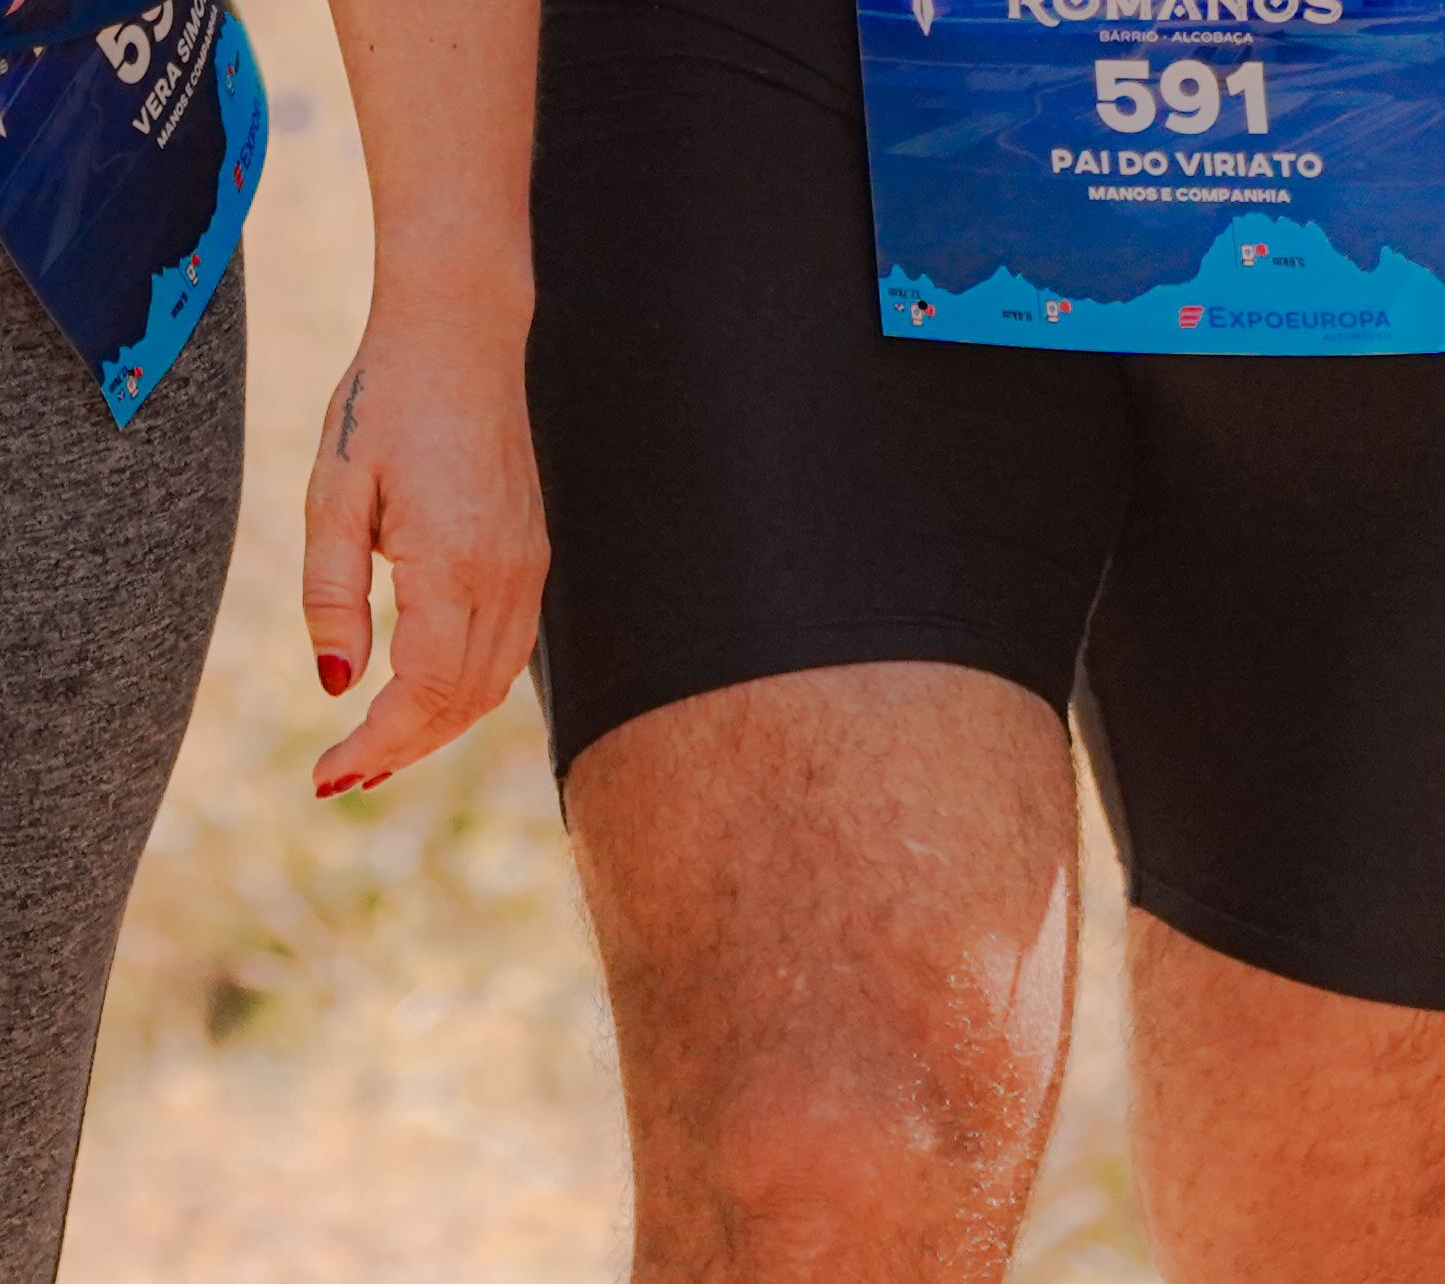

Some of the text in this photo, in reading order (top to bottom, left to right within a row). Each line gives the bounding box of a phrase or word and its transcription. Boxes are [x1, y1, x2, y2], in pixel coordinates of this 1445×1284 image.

[1171, 31, 1254, 46] ALCOBAÇA
[132, 62, 182, 134] VERA
[1095, 59, 1269, 135] 591
[156, 93, 189, 149] MANOS
[1051, 148, 1323, 178] PAI DO VIRIATO
[1088, 186, 1291, 203] MANOS E COMPANHIA
[1207, 306, 1392, 330] EXPOEUROPA
